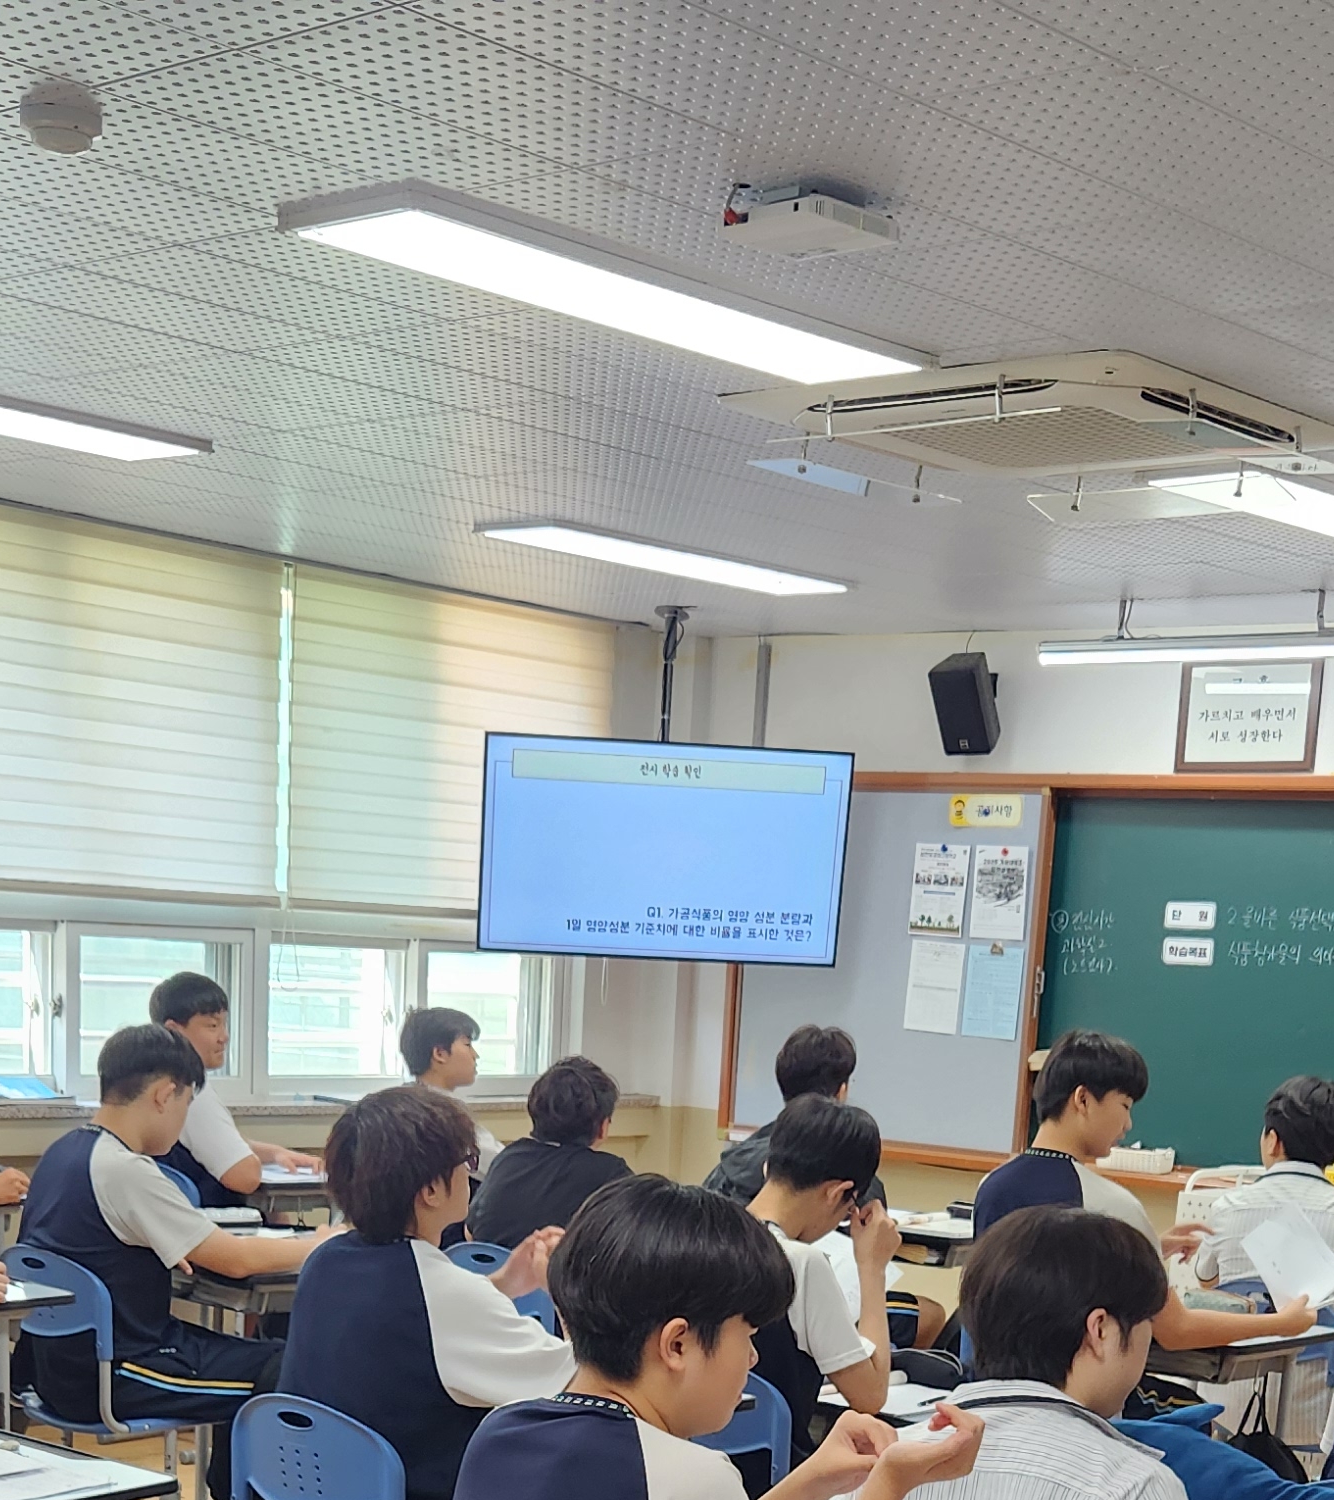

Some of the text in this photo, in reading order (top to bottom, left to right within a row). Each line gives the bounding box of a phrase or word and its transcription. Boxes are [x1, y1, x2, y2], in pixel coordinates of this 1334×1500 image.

[1198, 707, 1297, 722] 가르치고 배우면서
[1208, 729, 1283, 743] 서로 성장한다
[647, 906, 664, 919] Q1.
[669, 907, 723, 922] 가공식품의
[728, 910, 749, 923] 영양
[754, 911, 775, 924] 성분
[1171, 909, 1182, 921] 단
[1227, 906, 1237, 924] 2
[1242, 906, 1278, 930] 올바른
[566, 919, 581, 932] 1일
[587, 920, 630, 934] 영양성분
[635, 922, 678, 936] 기준치에
[683, 925, 705, 937] 대한
[746, 927, 779, 941] 표시한
[784, 929, 812, 942] 것은?
[1168, 945, 1208, 958] 학습목표
[1228, 940, 1302, 966] 식품첨가물의
